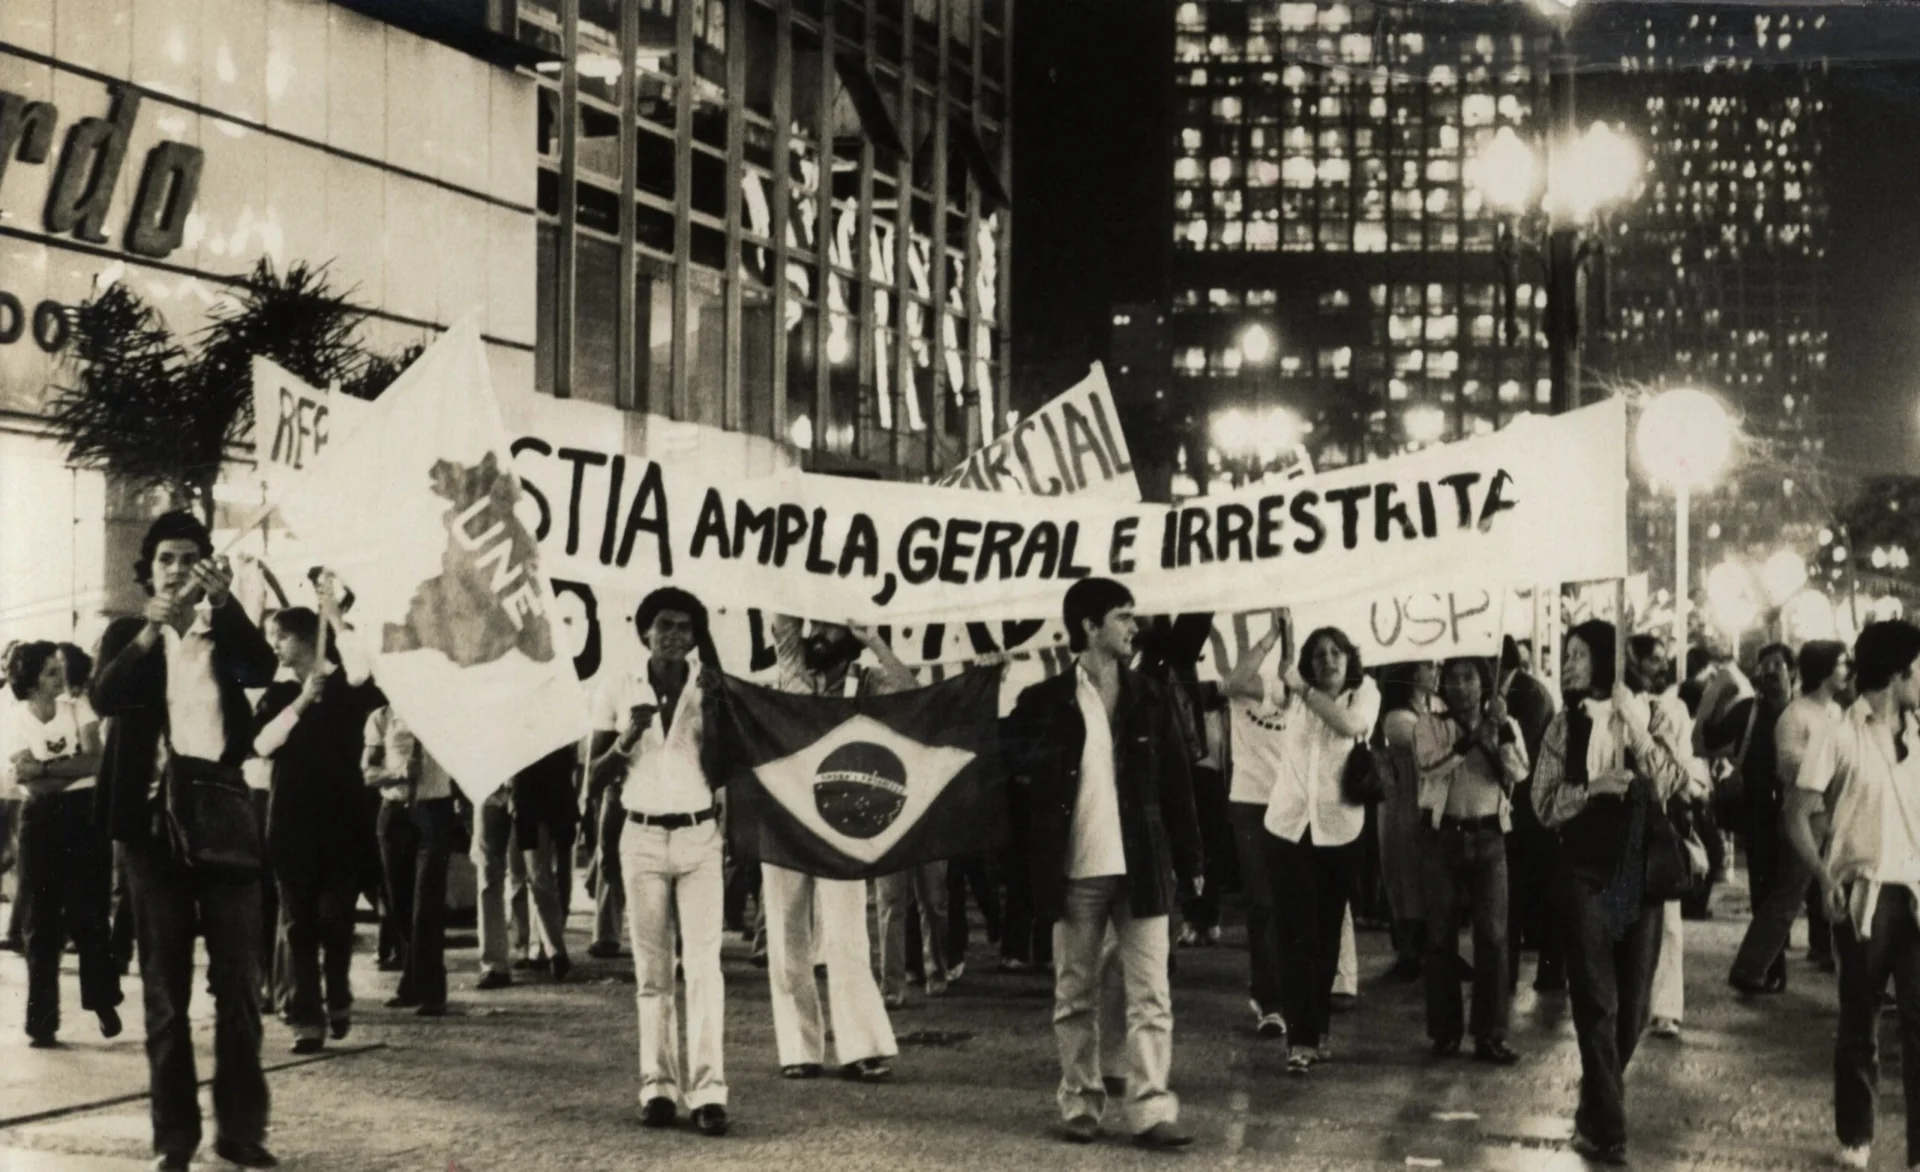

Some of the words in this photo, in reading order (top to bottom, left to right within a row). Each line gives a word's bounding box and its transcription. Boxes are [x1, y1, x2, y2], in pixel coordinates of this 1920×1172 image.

[452, 495, 544, 632] UNE
[897, 516, 1092, 585] GERAL
[1109, 516, 1140, 574] E
[1161, 468, 1520, 570] IRRESTRITA
